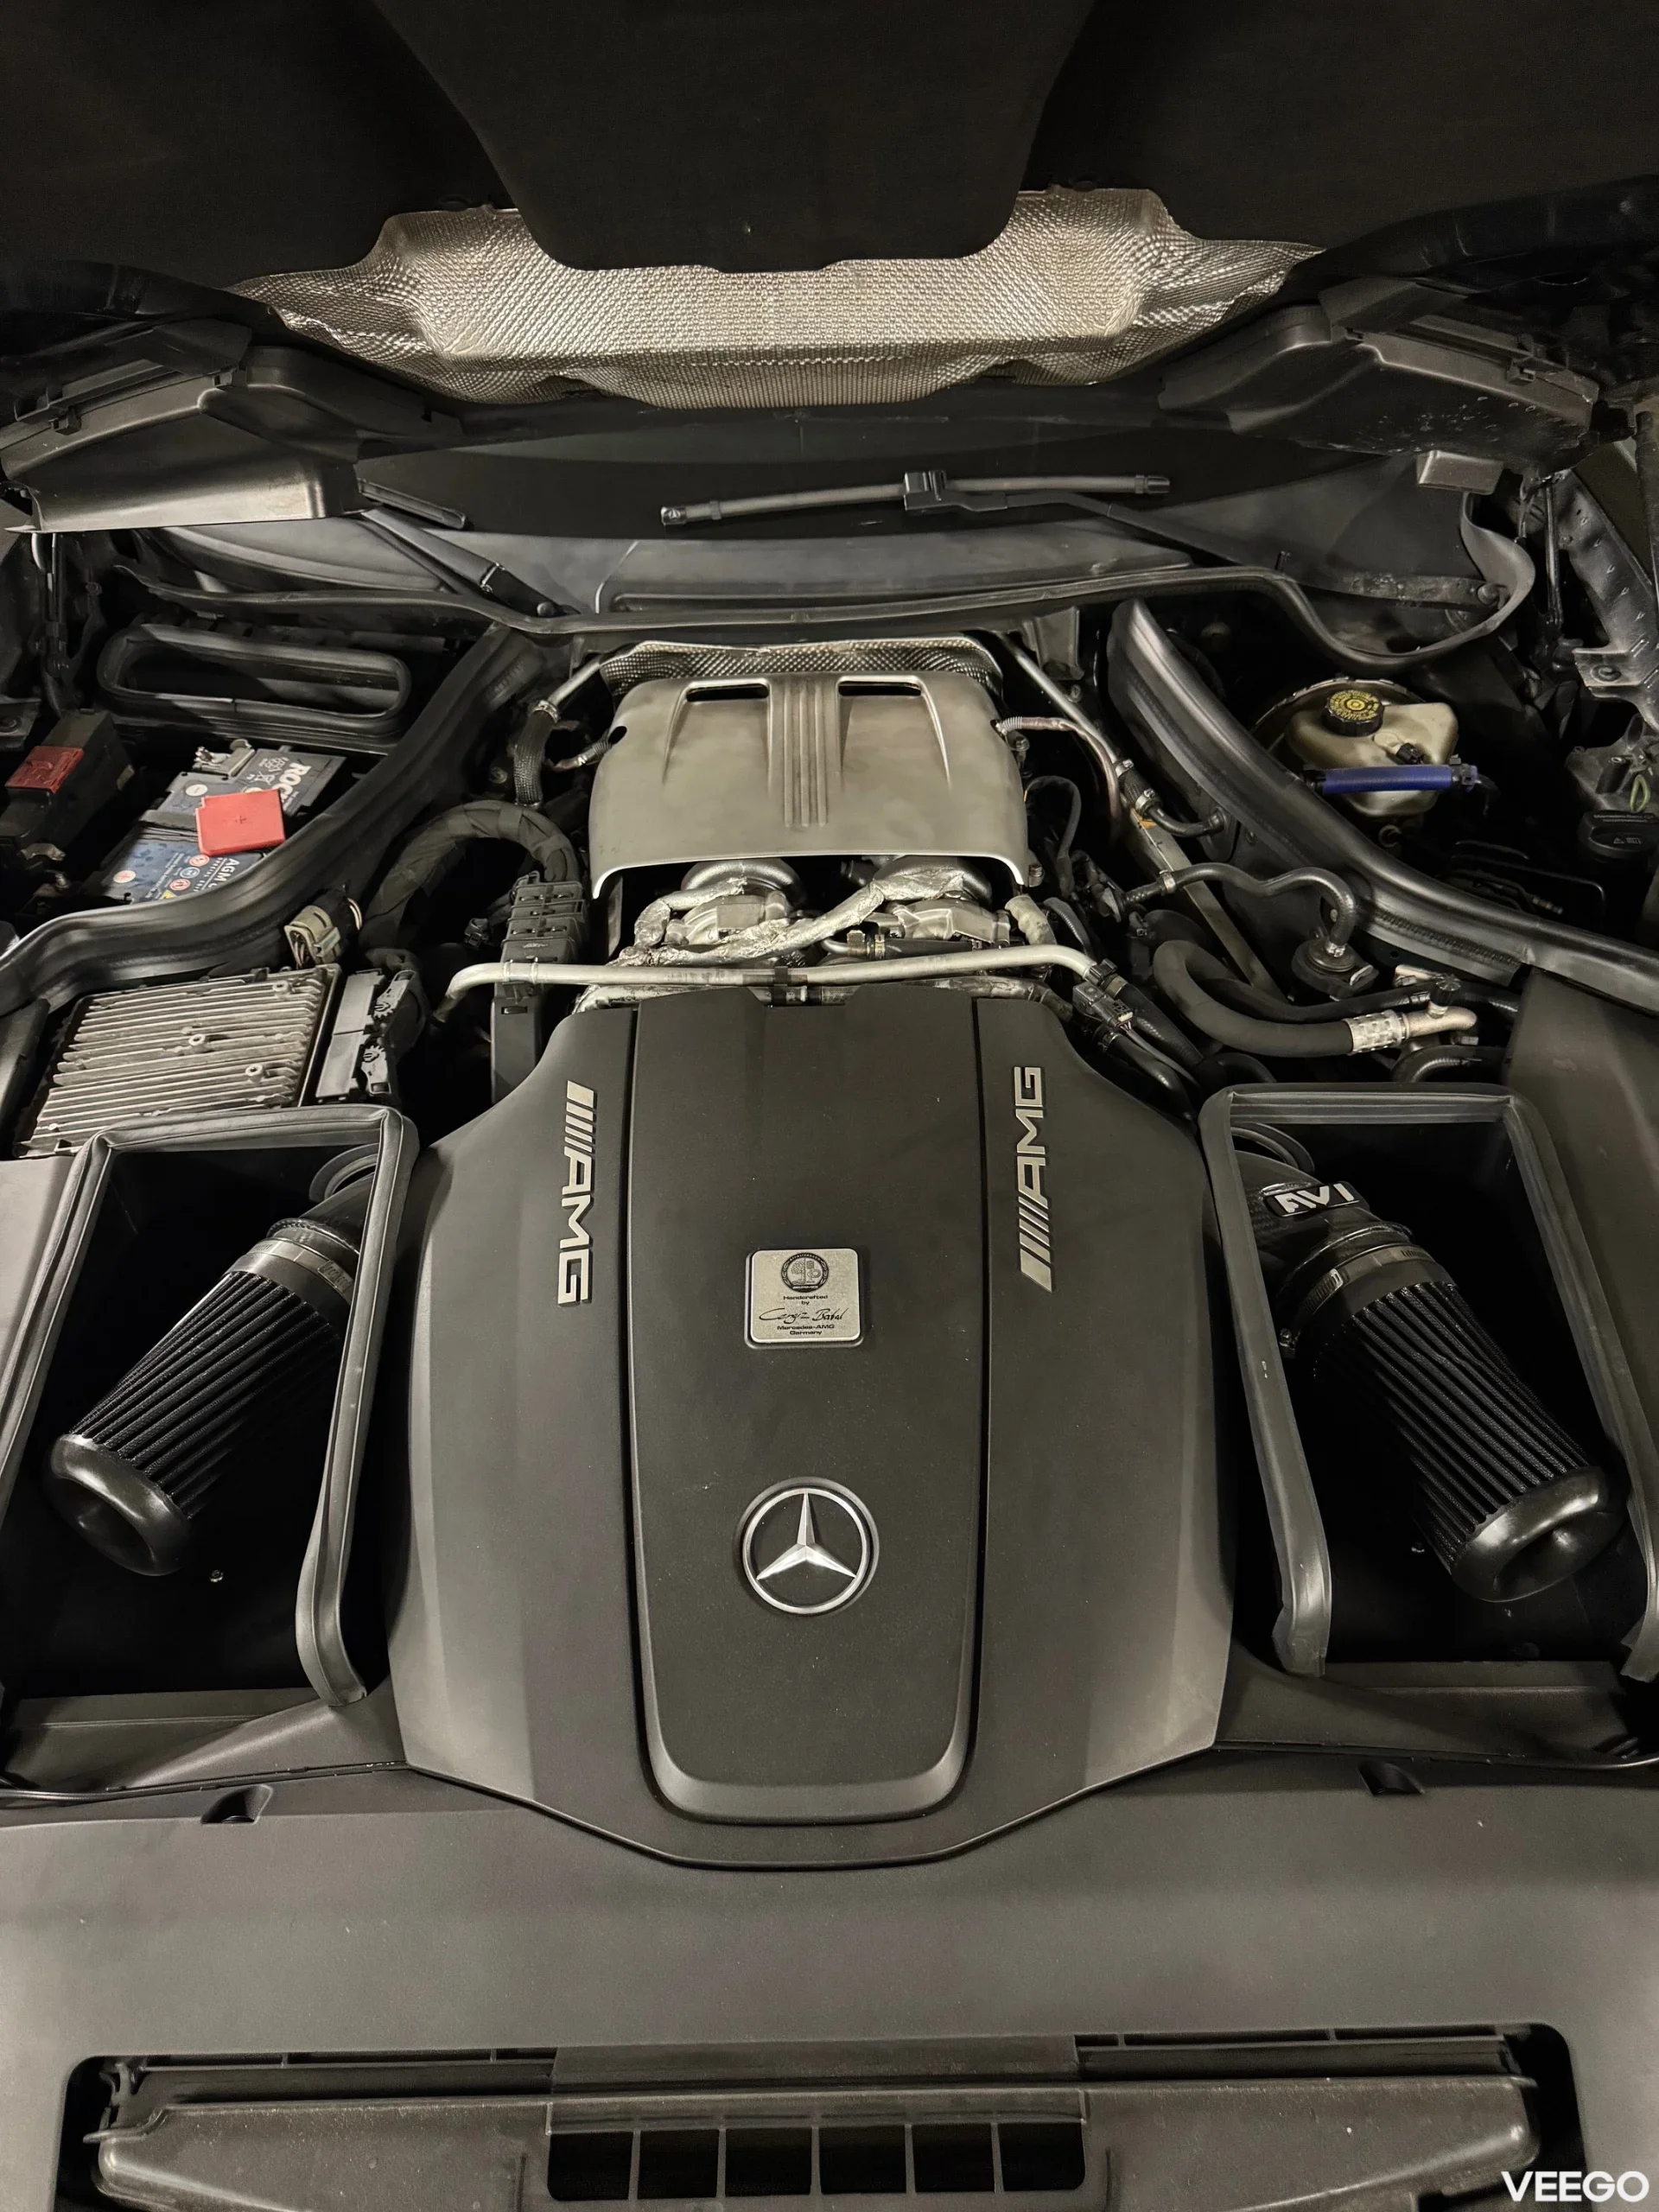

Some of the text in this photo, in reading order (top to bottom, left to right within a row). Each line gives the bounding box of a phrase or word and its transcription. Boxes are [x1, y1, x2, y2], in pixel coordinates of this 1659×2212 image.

[217, 858, 240, 882] AGM
[1014, 1066, 1049, 1210] AMG
[557, 1146, 593, 1305] AMG
